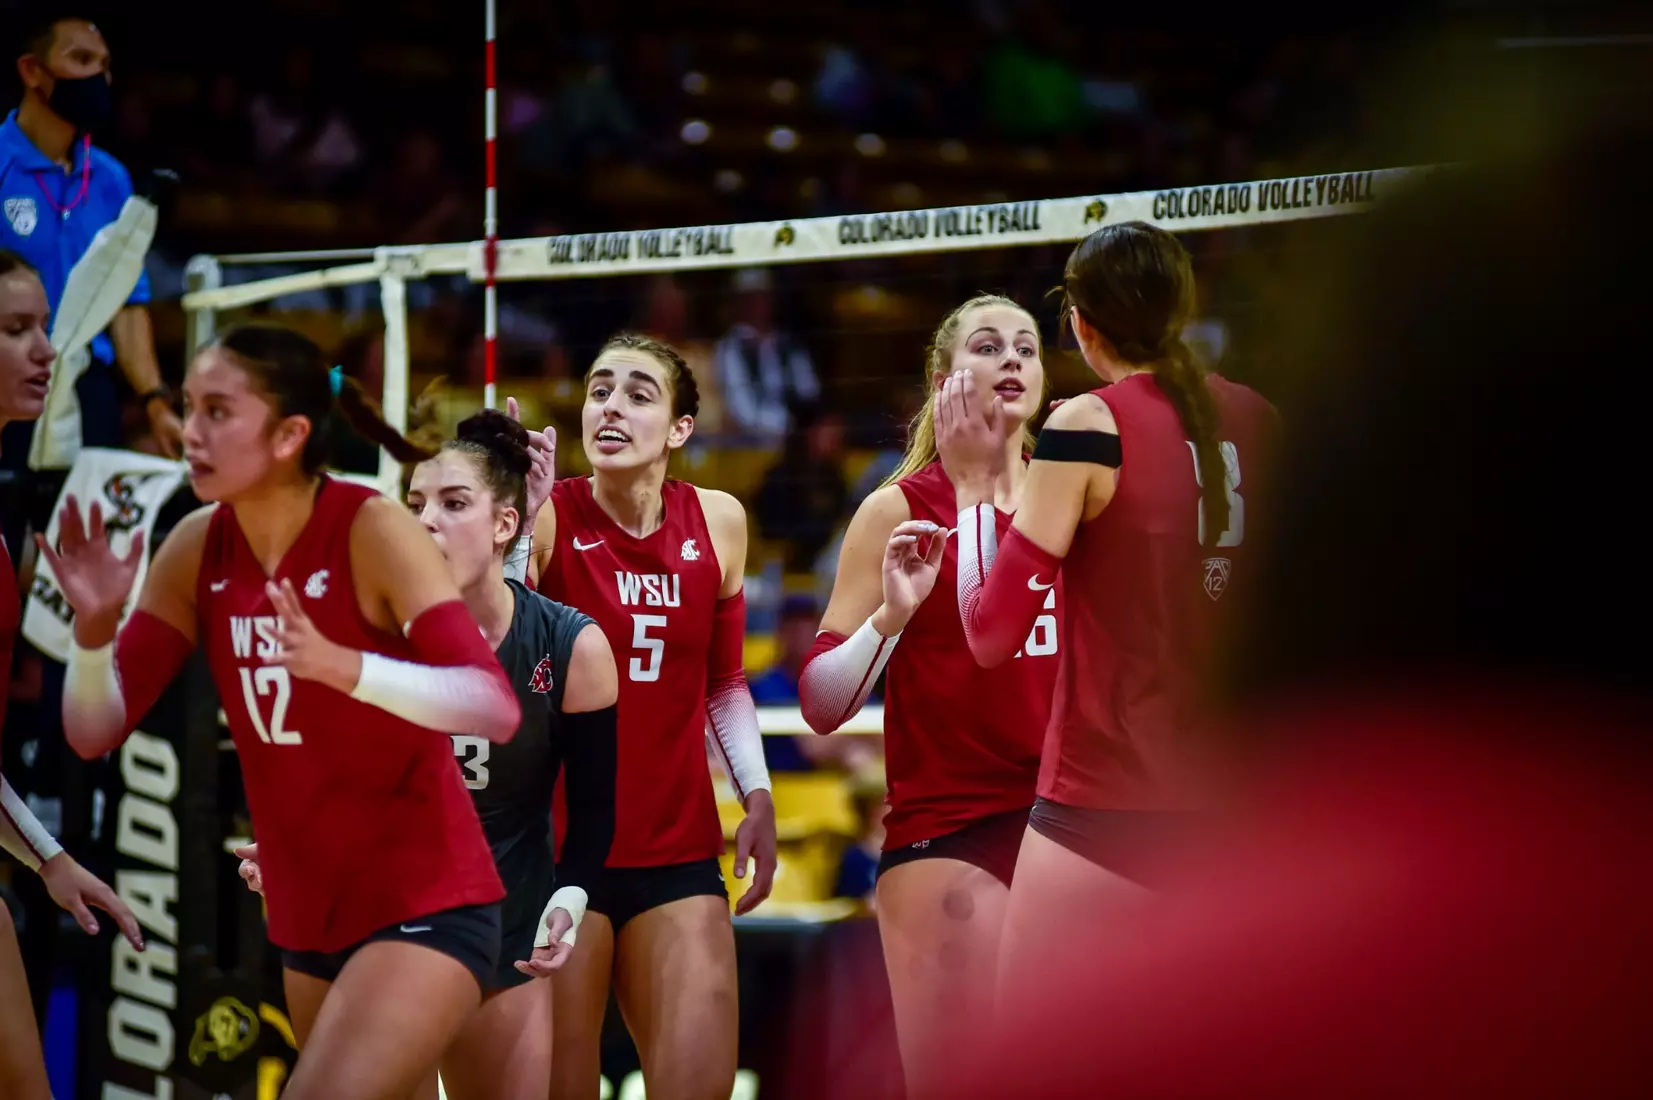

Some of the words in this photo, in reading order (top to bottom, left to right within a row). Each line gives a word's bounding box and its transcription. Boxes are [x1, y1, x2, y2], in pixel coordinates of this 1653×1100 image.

[1152, 185, 1251, 220] COLORADO
[1257, 172, 1375, 212] VOLLEYBALL
[838, 210, 929, 245] COLORADO
[934, 202, 1042, 237] VOLLEYBALL
[614, 570, 681, 607] WSU
[1208, 576, 1223, 591] 12
[628, 613, 668, 682] 5
[1013, 587, 1058, 658] 6
[238, 666, 303, 745] 12
[450, 735, 489, 790] 3
